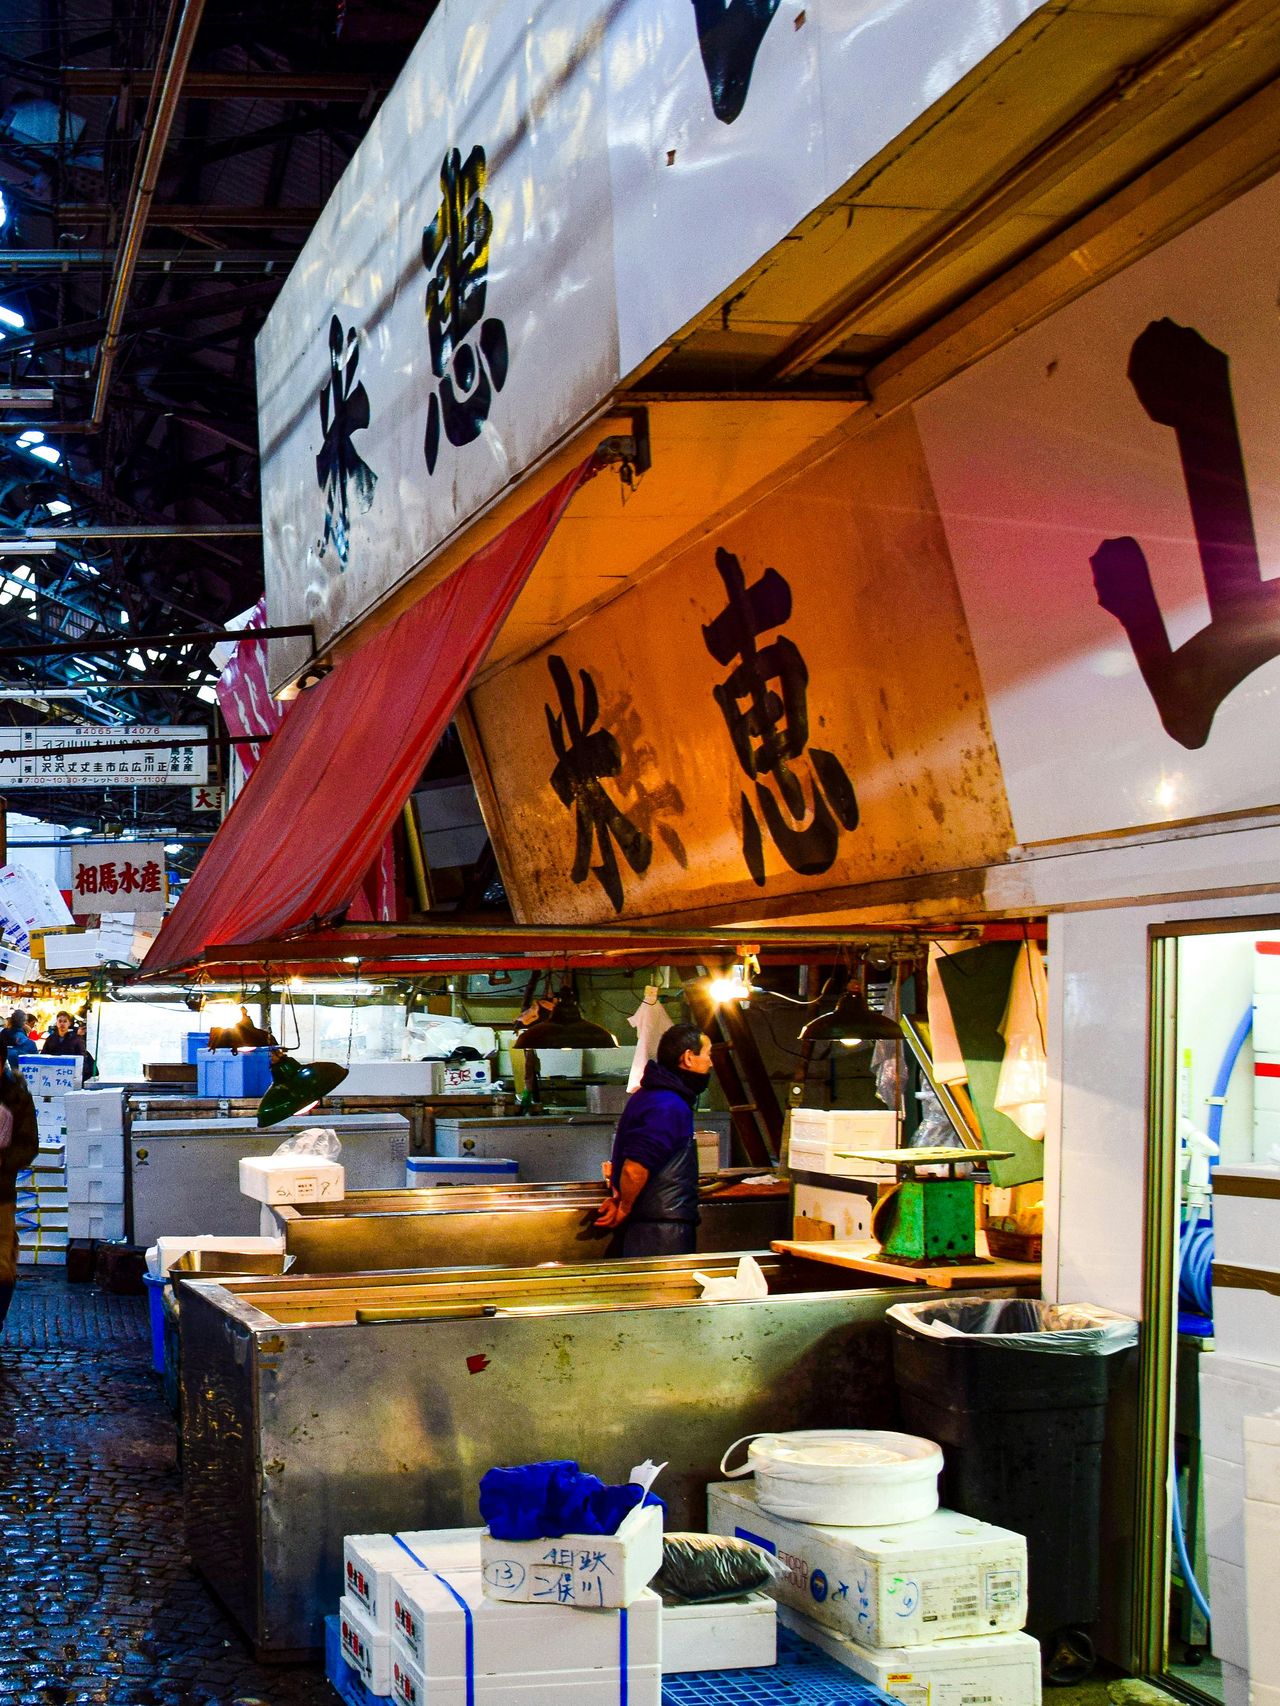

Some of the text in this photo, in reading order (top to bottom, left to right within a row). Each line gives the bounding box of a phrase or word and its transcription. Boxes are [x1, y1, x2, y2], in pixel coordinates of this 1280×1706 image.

[171, 739, 180, 772] 馬水産
[183, 739, 193, 772] 馬水産
[75, 860, 162, 896] 相馬水産
